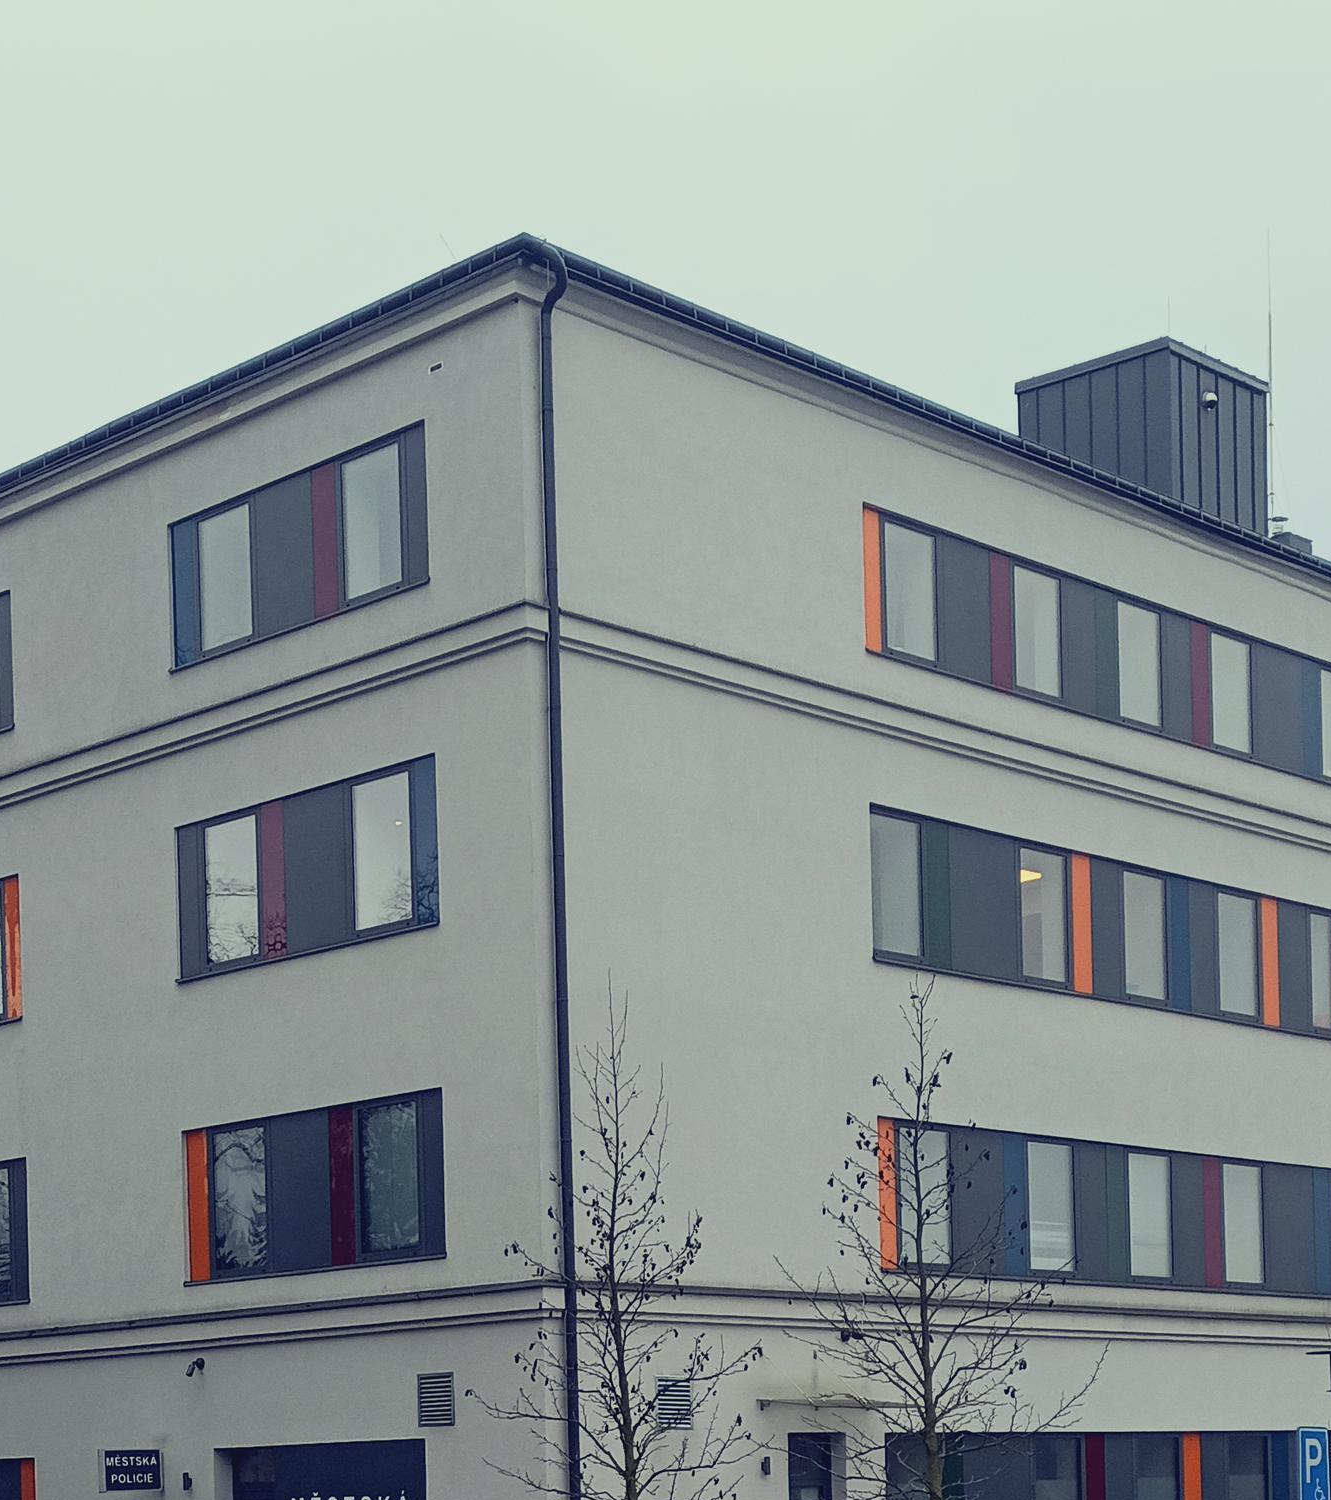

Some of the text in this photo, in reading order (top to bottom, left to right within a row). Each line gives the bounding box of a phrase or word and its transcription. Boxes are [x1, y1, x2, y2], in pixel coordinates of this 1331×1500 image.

[106, 1453, 157, 1467] MĚSTSKÁ
[1305, 1438, 1323, 1484] P
[111, 1473, 154, 1484] POLICIE
